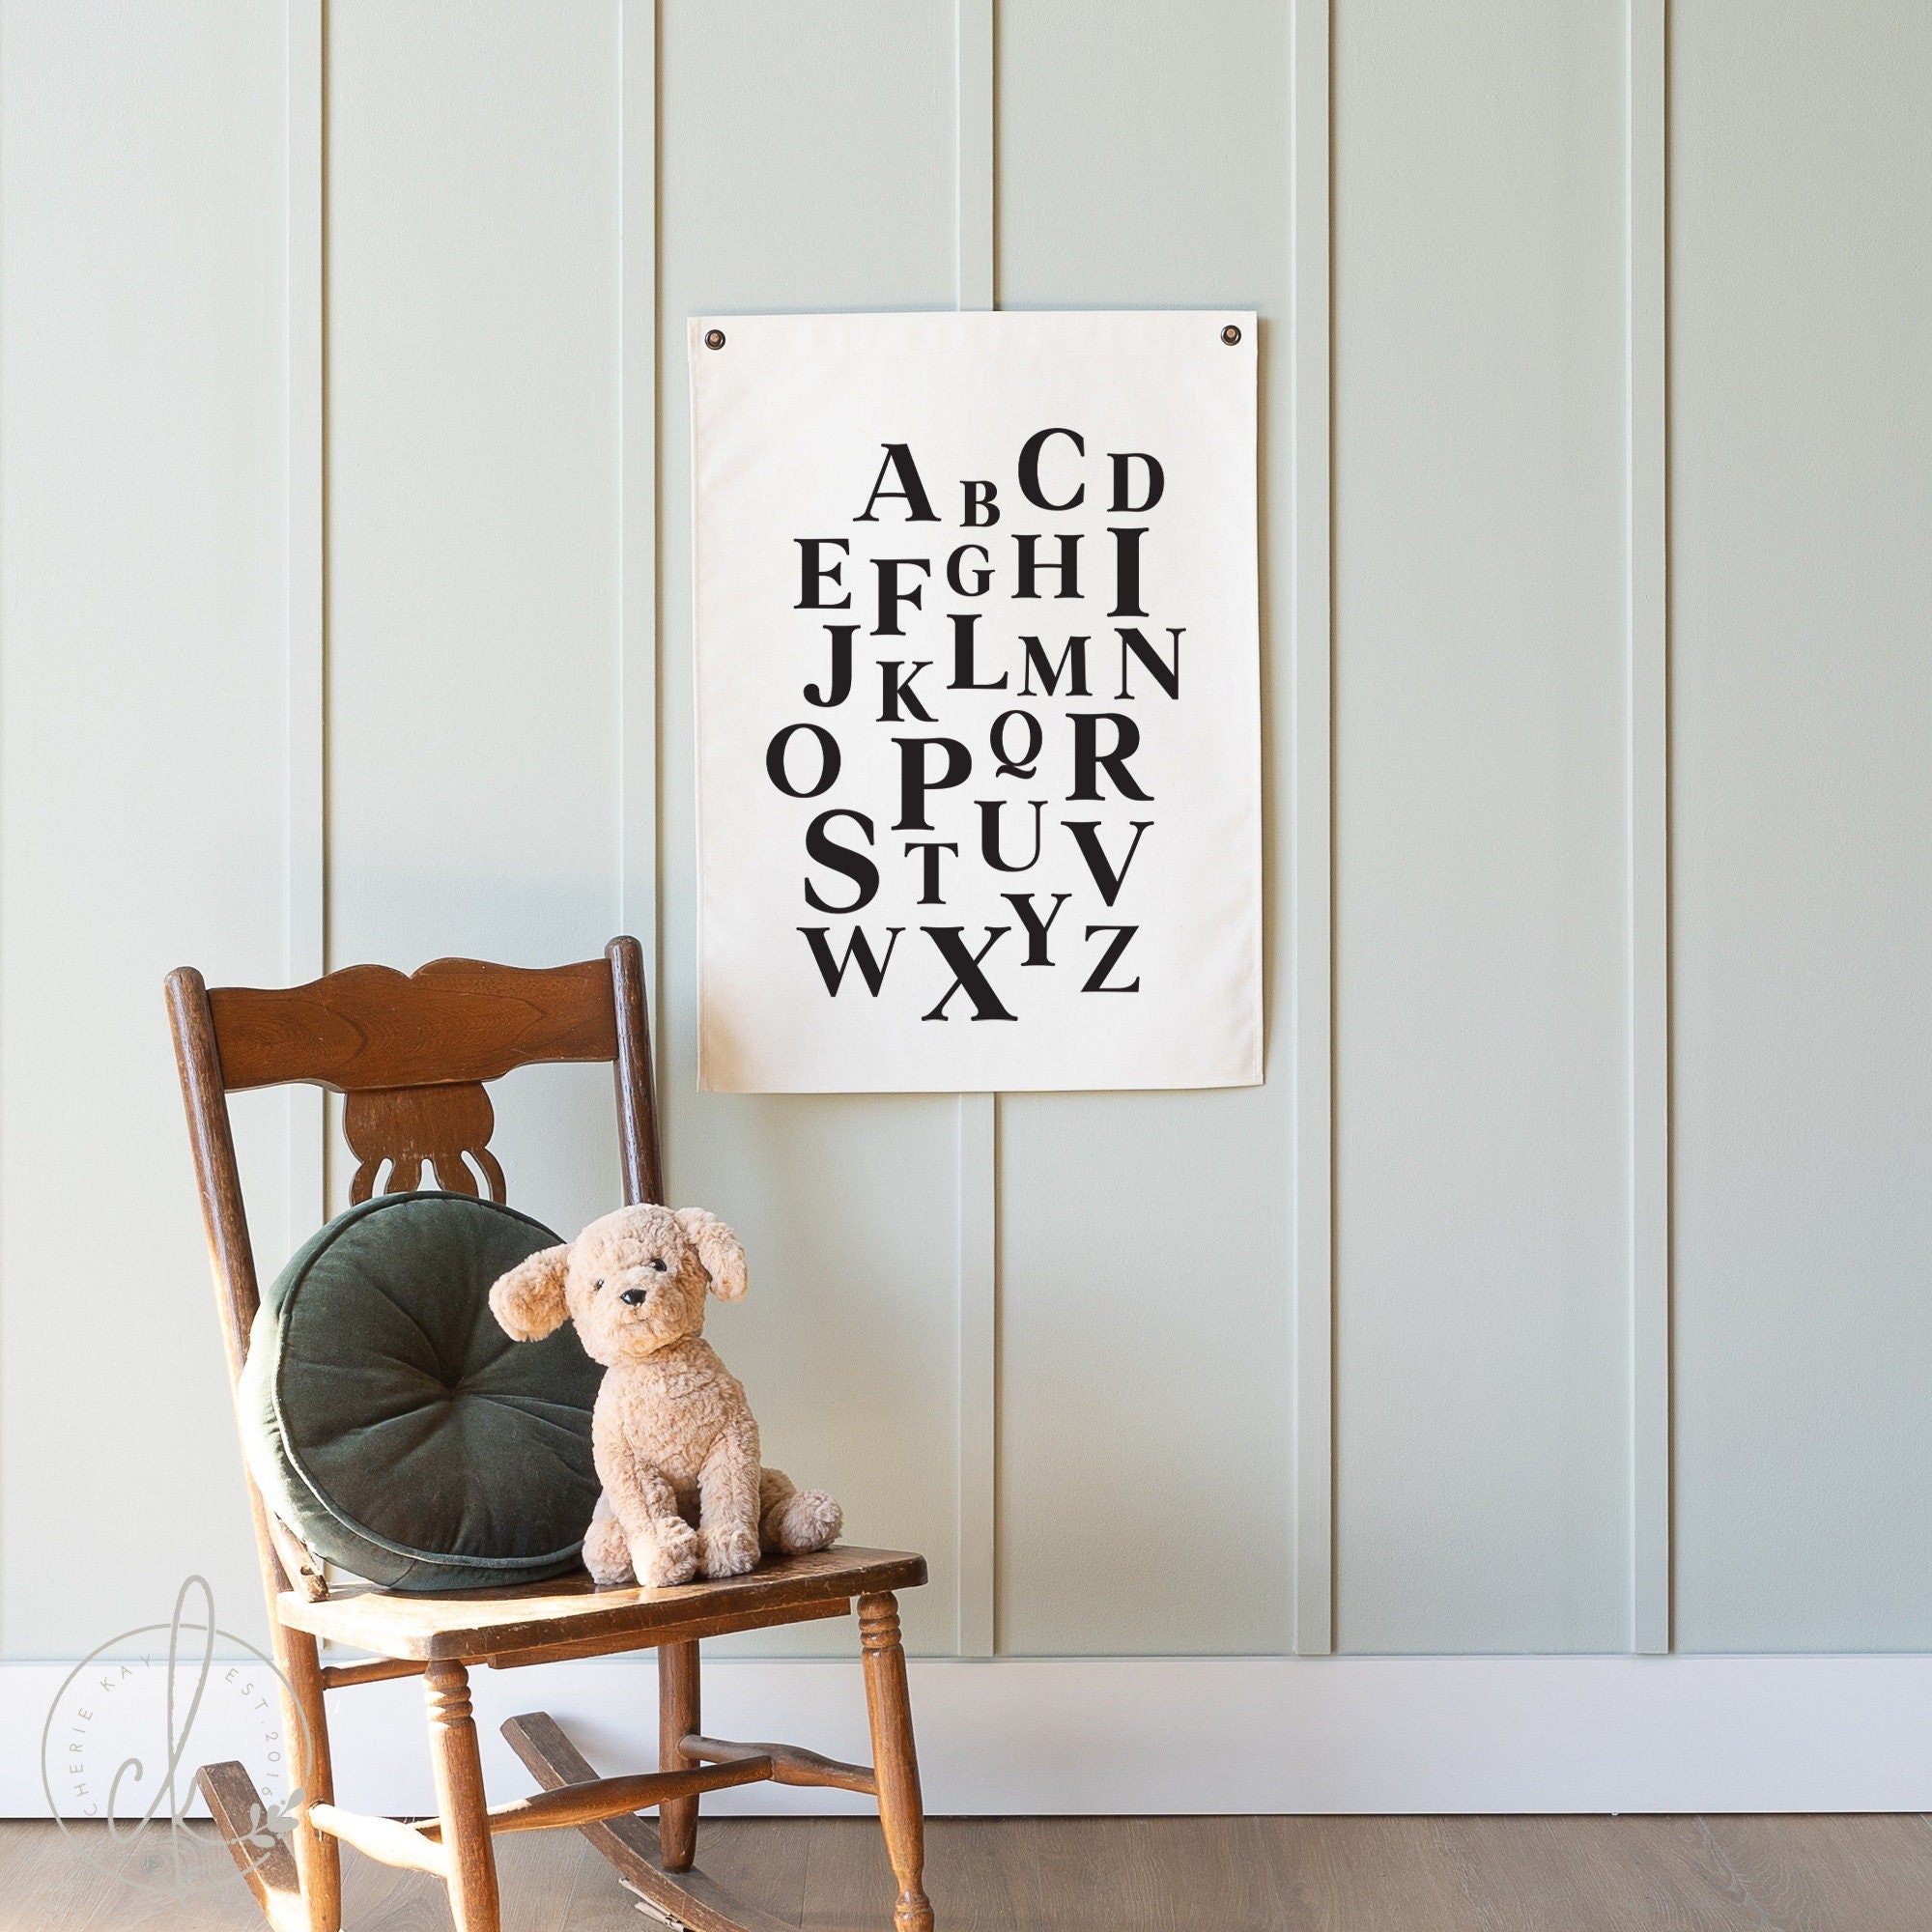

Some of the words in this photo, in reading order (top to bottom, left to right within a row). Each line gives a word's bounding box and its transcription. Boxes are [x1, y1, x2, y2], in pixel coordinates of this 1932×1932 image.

[852, 442, 942, 523] A
[959, 480, 1001, 527] B
[1017, 427, 1085, 512] C
[1106, 452, 1165, 513] D
[793, 538, 852, 610] E
[869, 558, 931, 637] F
[946, 544, 996, 597] G
[1010, 533, 1085, 599] H
[1106, 526, 1150, 618] I
[803, 624, 862, 708] J
[875, 660, 939, 723] K
[946, 613, 1009, 690] L
[1016, 636, 1094, 696] M
[1114, 627, 1187, 700] N
[765, 723, 841, 799] O
[891, 737, 973, 831] P
[989, 709, 1043, 780] Q
[1065, 712, 1155, 802] R
[804, 809, 880, 915] S
[904, 842, 959, 905] T
[973, 800, 1049, 872] U
[1060, 820, 1155, 907] V
[795, 924, 906, 998] W
[919, 925, 1018, 1022] X
[1000, 893, 1073, 967] Y
[1080, 924, 1141, 993] Z
